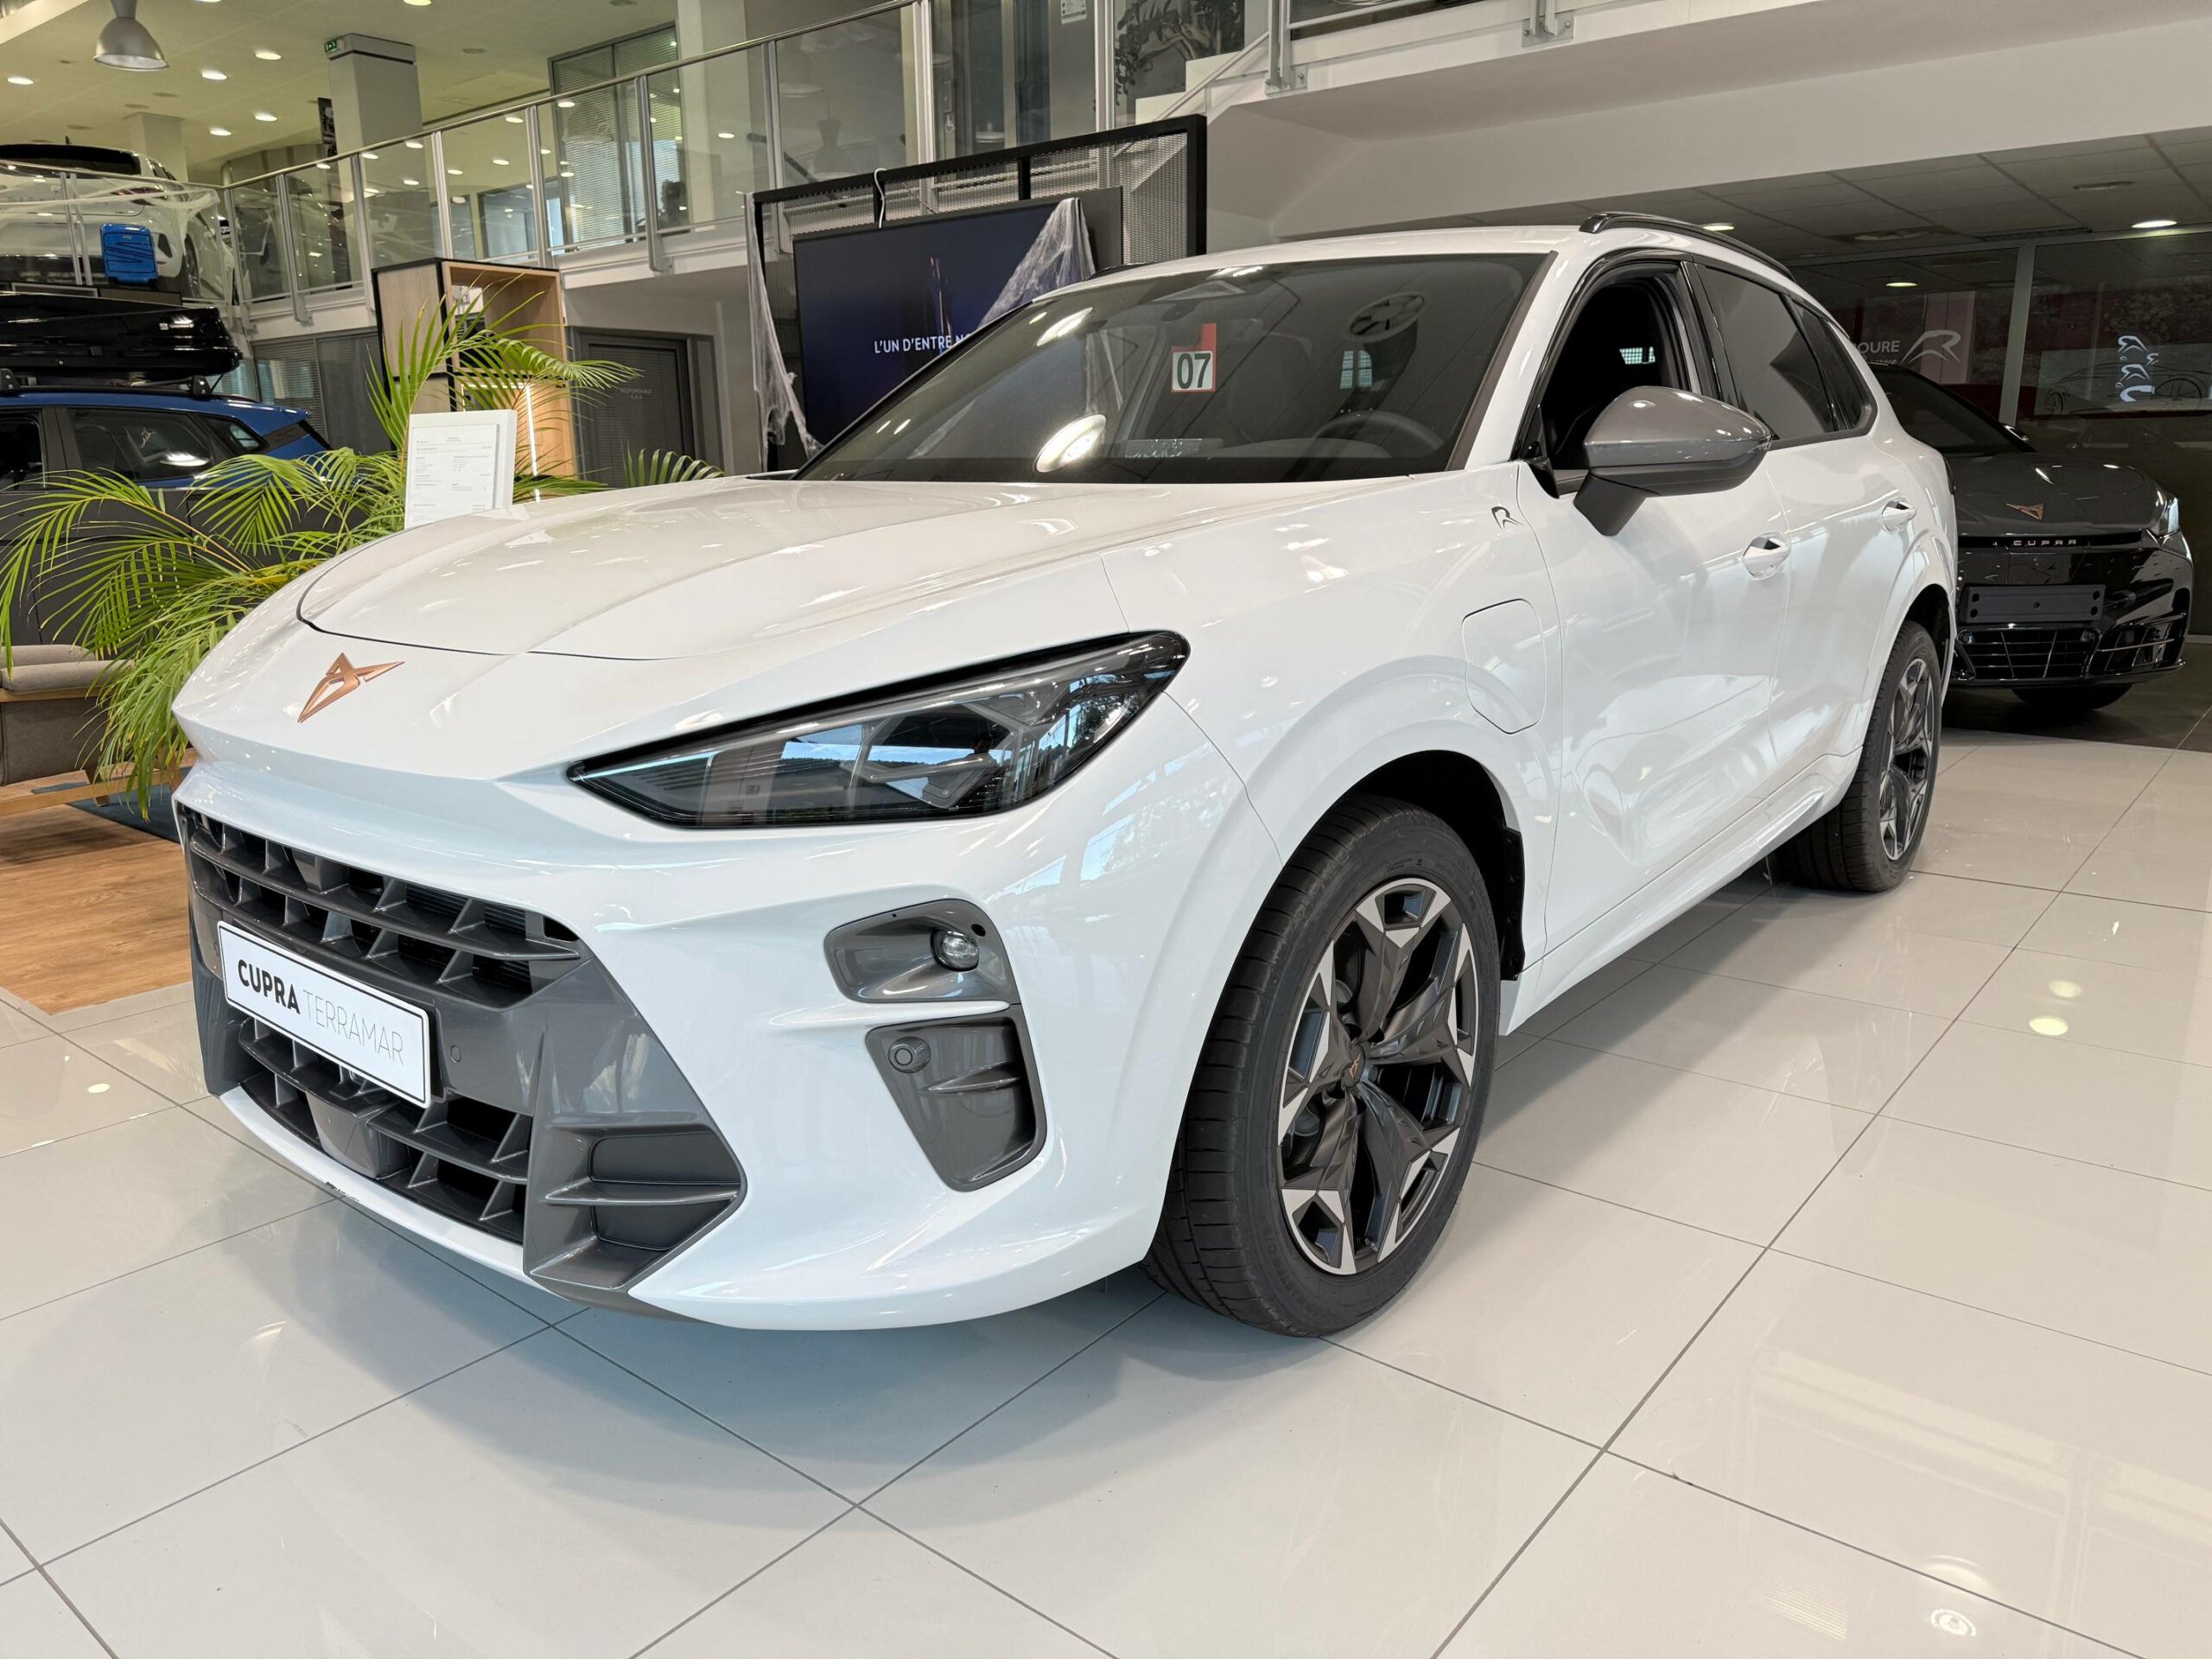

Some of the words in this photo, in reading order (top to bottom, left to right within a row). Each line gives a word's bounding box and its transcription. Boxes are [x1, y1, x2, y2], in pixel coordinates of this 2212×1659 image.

[874, 339, 899, 353] L'UN
[902, 335, 951, 352] D'ENTRE
[1853, 340, 1900, 354] OURE
[1177, 353, 1211, 390] 07
[238, 958, 301, 1014] CUPRA
[302, 989, 404, 1065] TERRAMAR
